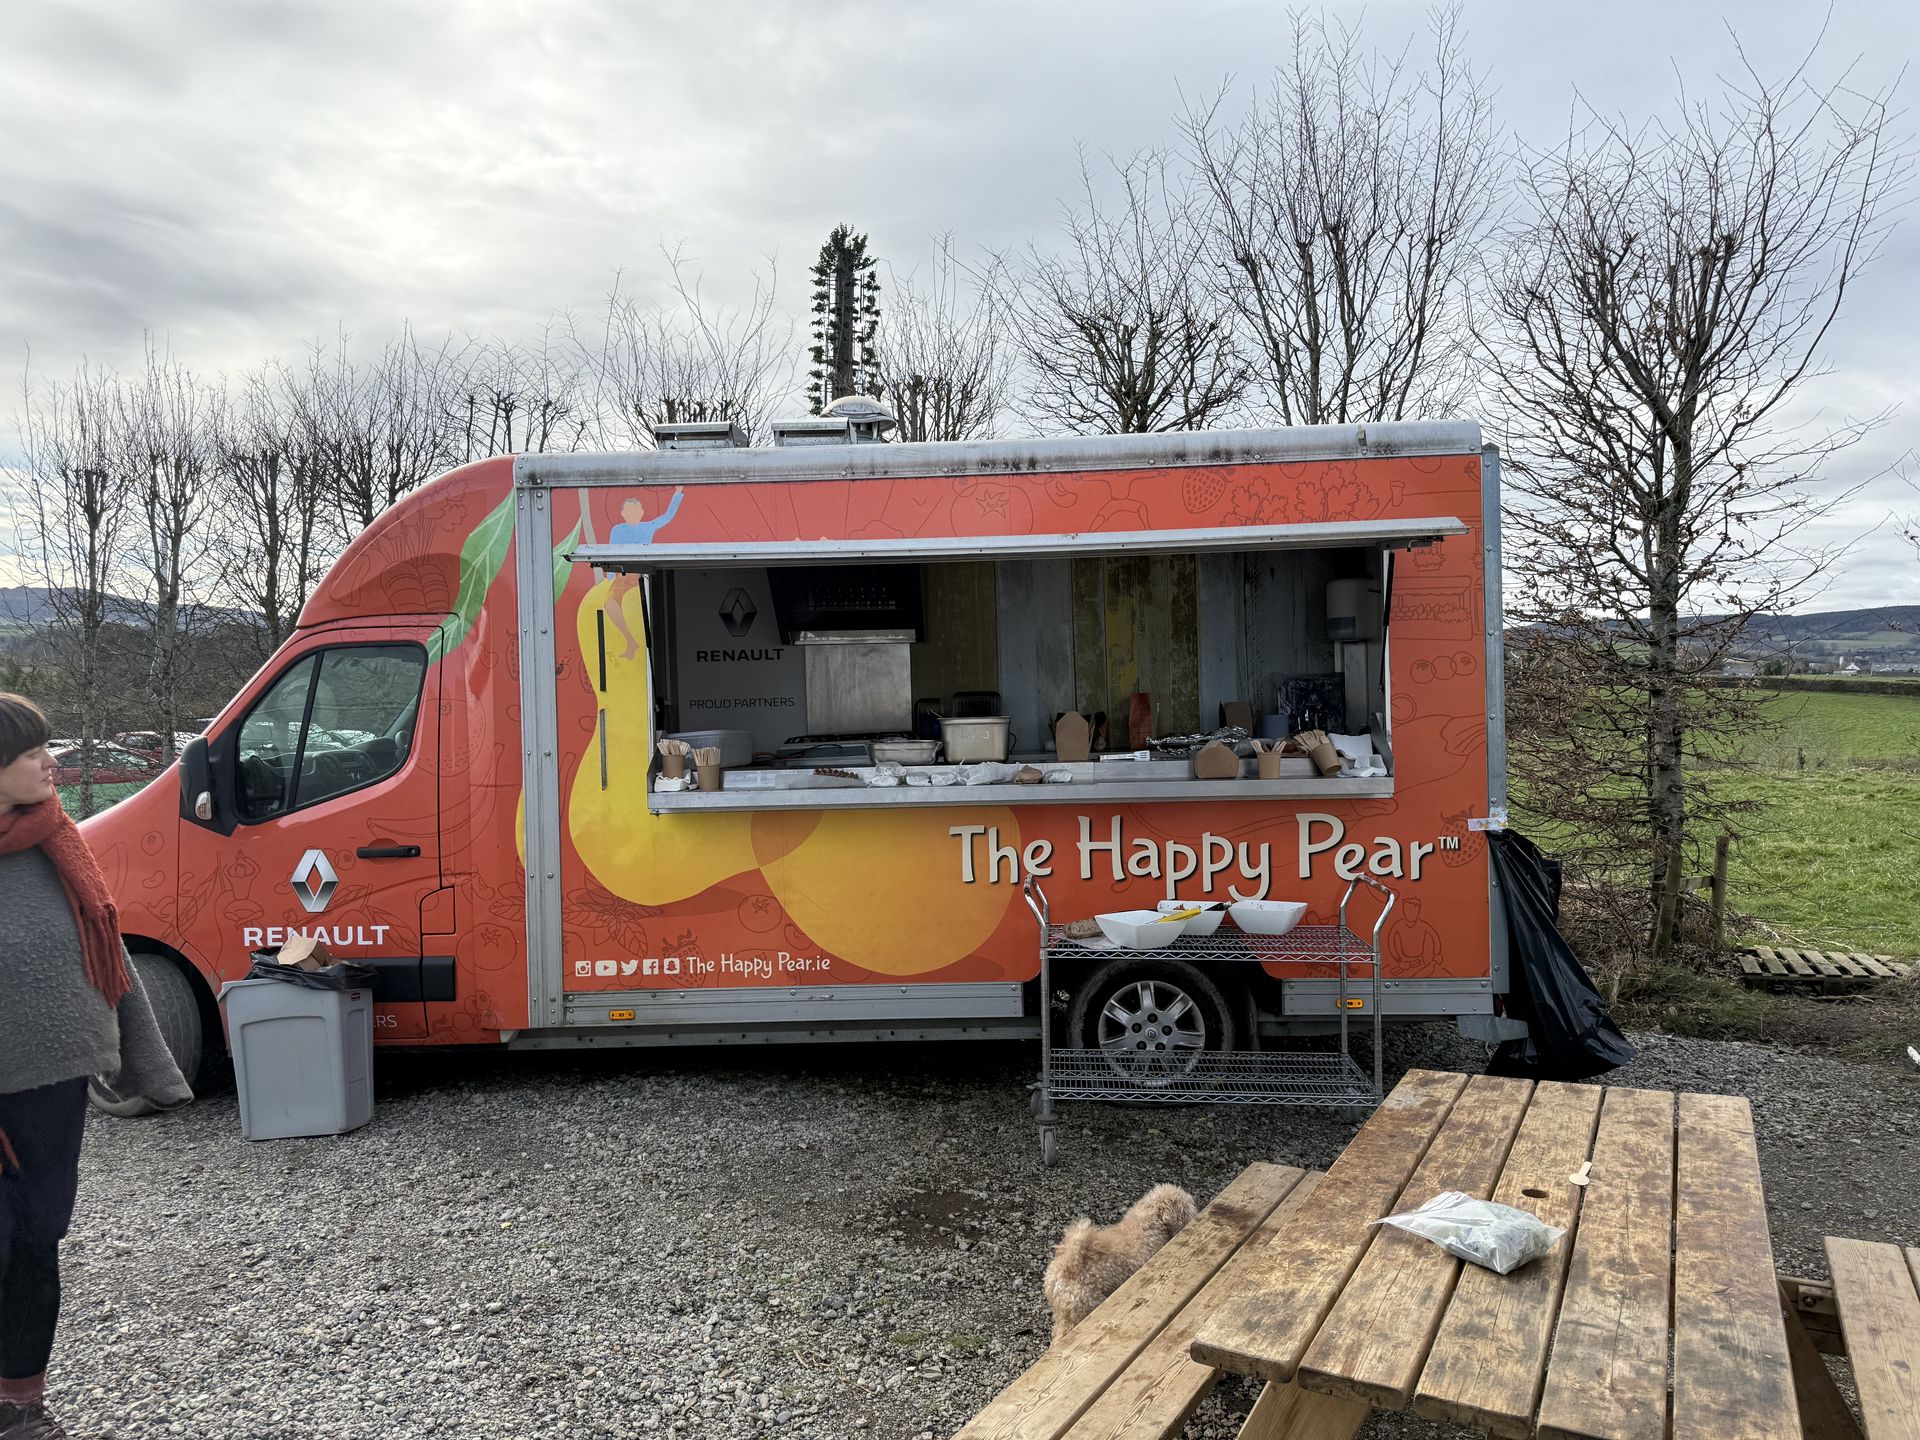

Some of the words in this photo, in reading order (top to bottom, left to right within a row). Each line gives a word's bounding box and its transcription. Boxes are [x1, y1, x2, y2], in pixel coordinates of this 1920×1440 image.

[696, 648, 784, 662] RENAULT
[689, 699, 731, 709] PROUD
[734, 697, 795, 708] PARTNERS
[949, 825, 1053, 884] The
[1076, 815, 1272, 901] Happy
[686, 956, 715, 974] The
[721, 953, 773, 979] Happy
[777, 952, 831, 972] Pear.ie
